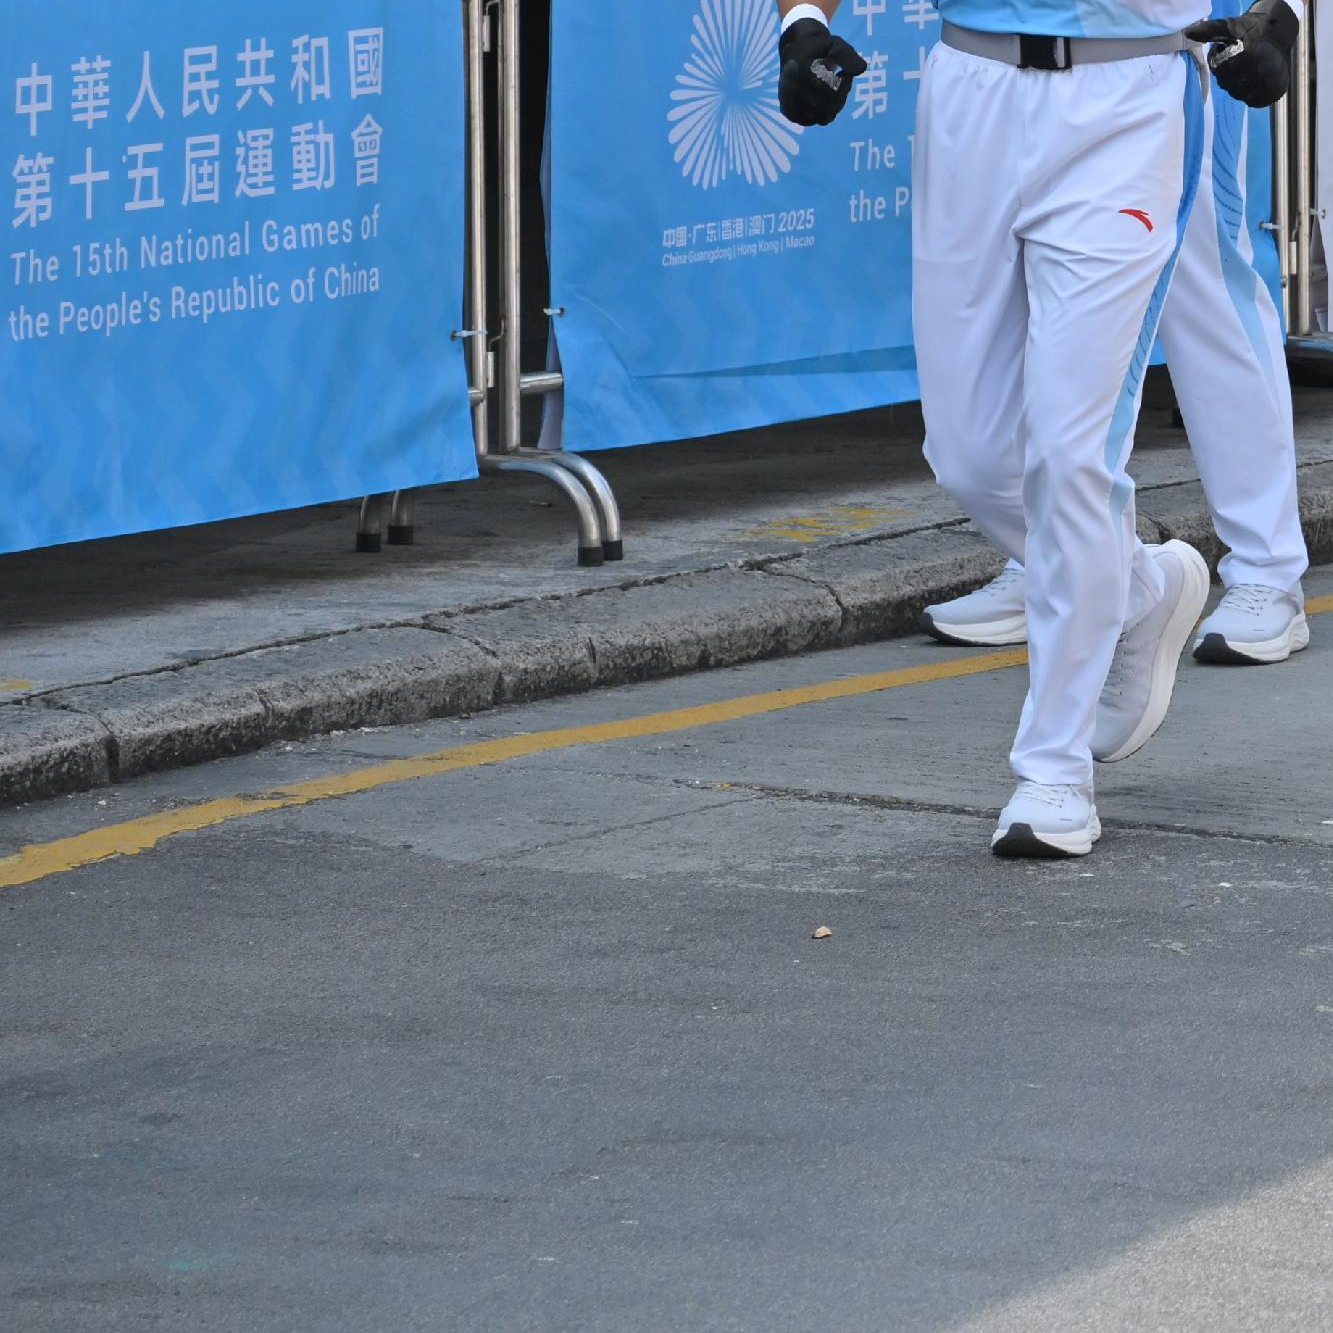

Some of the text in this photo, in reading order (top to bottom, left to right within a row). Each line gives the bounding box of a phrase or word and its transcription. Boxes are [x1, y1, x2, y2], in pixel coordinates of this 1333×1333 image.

[15, 27, 384, 136] 中華人民共和國
[11, 114, 384, 229] 第十五屆運動會
[850, 138, 896, 172] The
[778, 208, 815, 232] 2025
[849, 189, 886, 222] the
[10, 205, 380, 285] The 15th National Games of
[737, 243, 757, 257] Hong
[759, 239, 779, 254] Kong
[786, 235, 815, 250] Macao
[8, 261, 380, 342] the People's Republic of China
